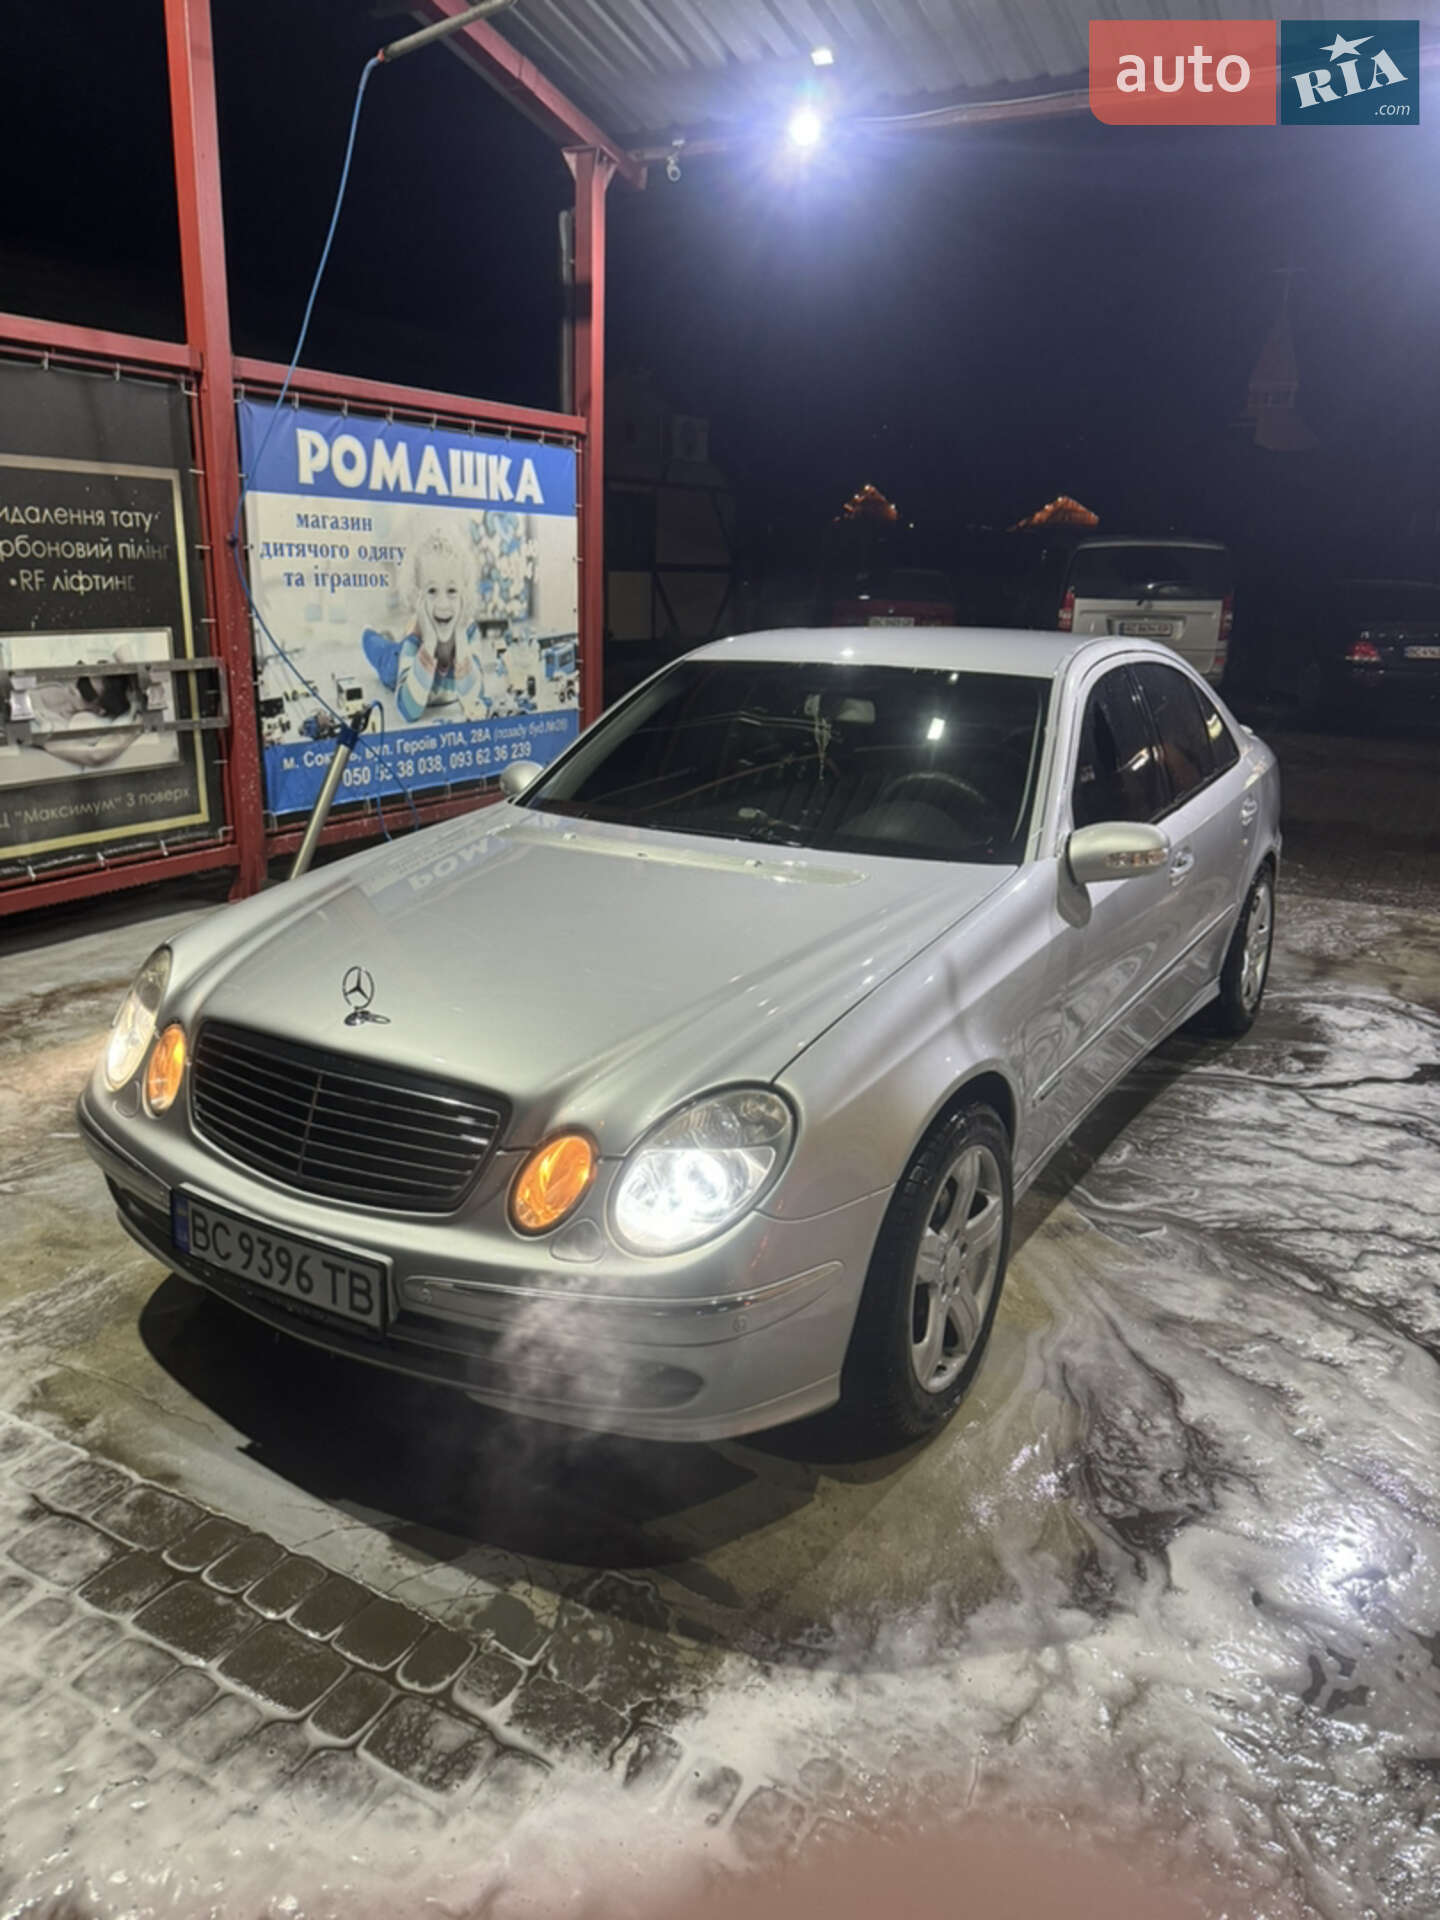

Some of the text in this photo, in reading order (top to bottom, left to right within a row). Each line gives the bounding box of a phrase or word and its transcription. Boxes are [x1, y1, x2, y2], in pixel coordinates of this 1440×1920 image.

[296, 428, 544, 505] РОМАШКА
[296, 512, 373, 532] магазин
[259, 541, 405, 567] дитячого одягу
[283, 564, 390, 593] та іграшок
[396, 735, 437, 756] Героїв
[440, 730, 468, 748] УПА,
[342, 765, 371, 787] 050
[397, 759, 414, 778] 38
[418, 754, 447, 775] 038,
[451, 749, 473, 769] 093
[476, 747, 491, 765] 62
[494, 744, 509, 762] 36
[511, 740, 532, 758] 239
[126, 792, 136, 808] 3
[139, 787, 190, 807] поверх
